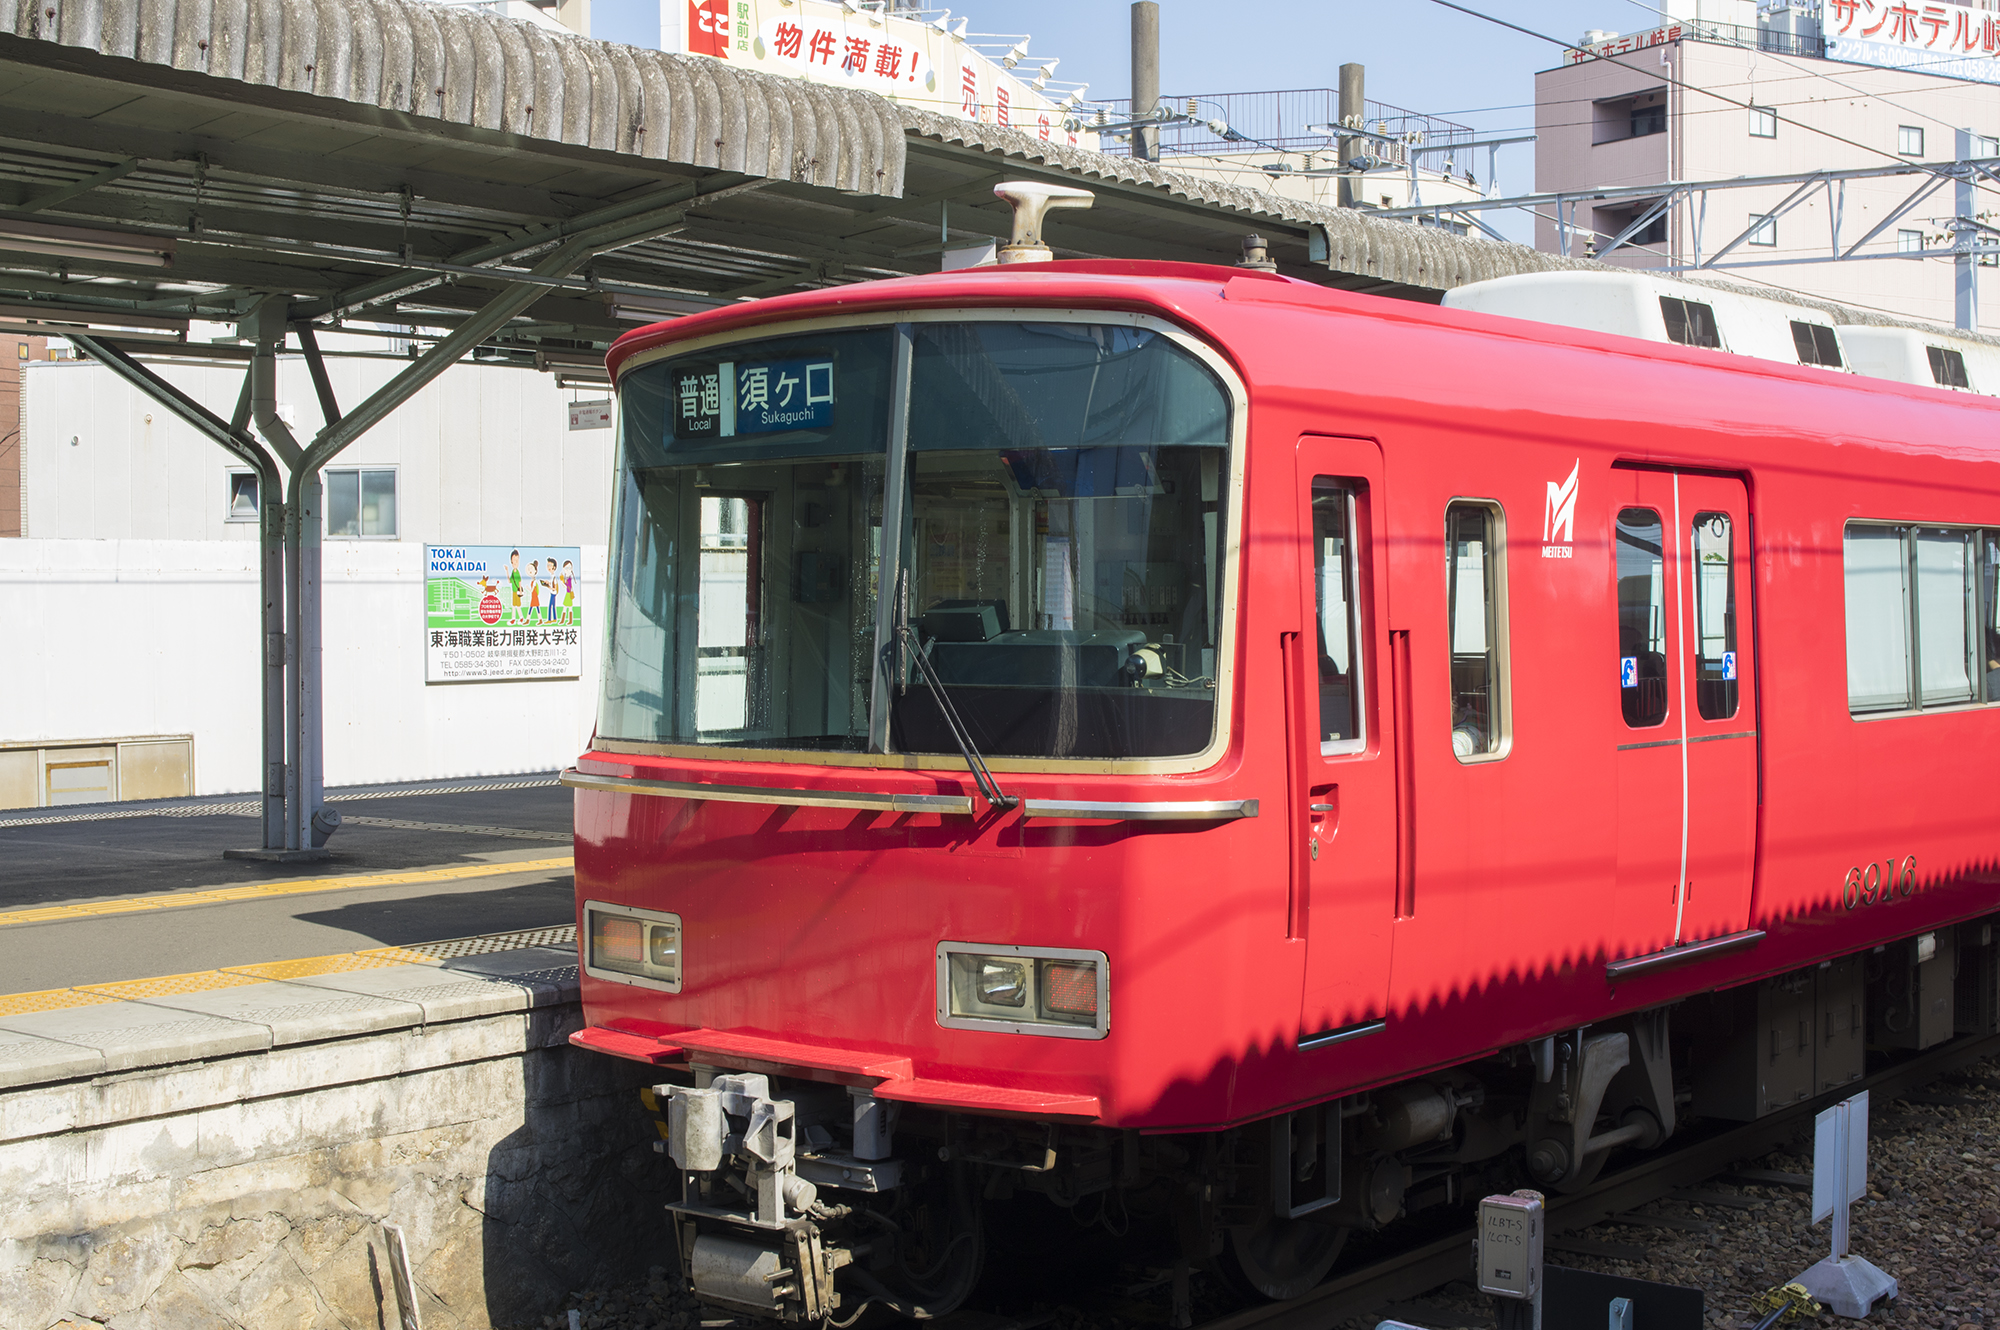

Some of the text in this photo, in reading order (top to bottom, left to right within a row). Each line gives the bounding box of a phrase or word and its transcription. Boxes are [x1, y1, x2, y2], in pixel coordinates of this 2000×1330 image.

[736, 2, 749, 51] 駅前店
[774, 21, 919, 82] 物件満載!
[680, 374, 719, 418] 普通
[761, 407, 814, 425] Sukaguchi
[688, 418, 711, 431] Local
[431, 549, 466, 559] TOKAI
[1542, 546, 1572, 558] MEITETSU
[431, 561, 487, 572] NOKAIDAI
[430, 629, 578, 648] 東海職業能力開発大学校
[440, 661, 453, 669] TEL
[508, 659, 522, 667] FAX
[443, 667, 567, 677] http://www3.jeed.or.jp/gifu/college/
[1843, 855, 1917, 911] 6916
